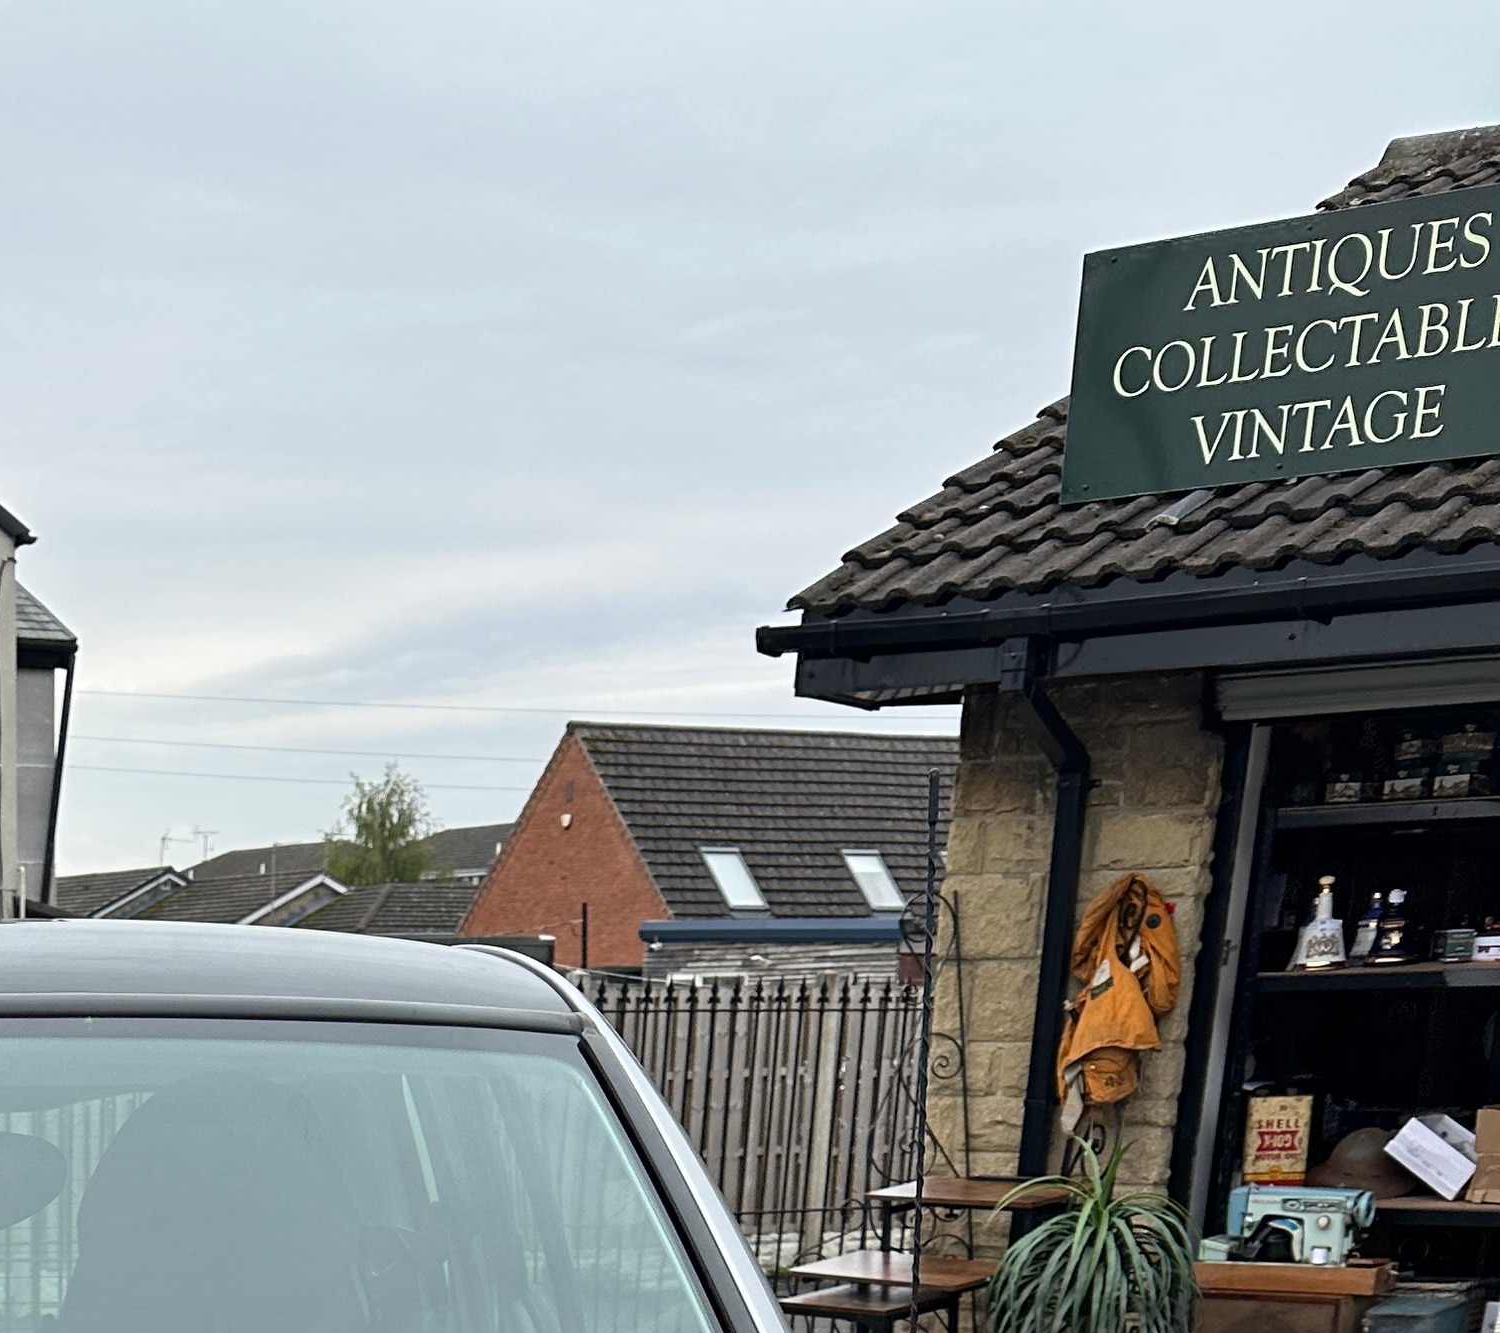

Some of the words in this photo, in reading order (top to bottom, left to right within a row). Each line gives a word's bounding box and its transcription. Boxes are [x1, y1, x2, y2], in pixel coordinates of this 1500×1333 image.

[1183, 212, 1493, 311] ANTIQUES
[1190, 384, 1446, 466] VINTAGE
[1256, 1118, 1301, 1130] SHELL
